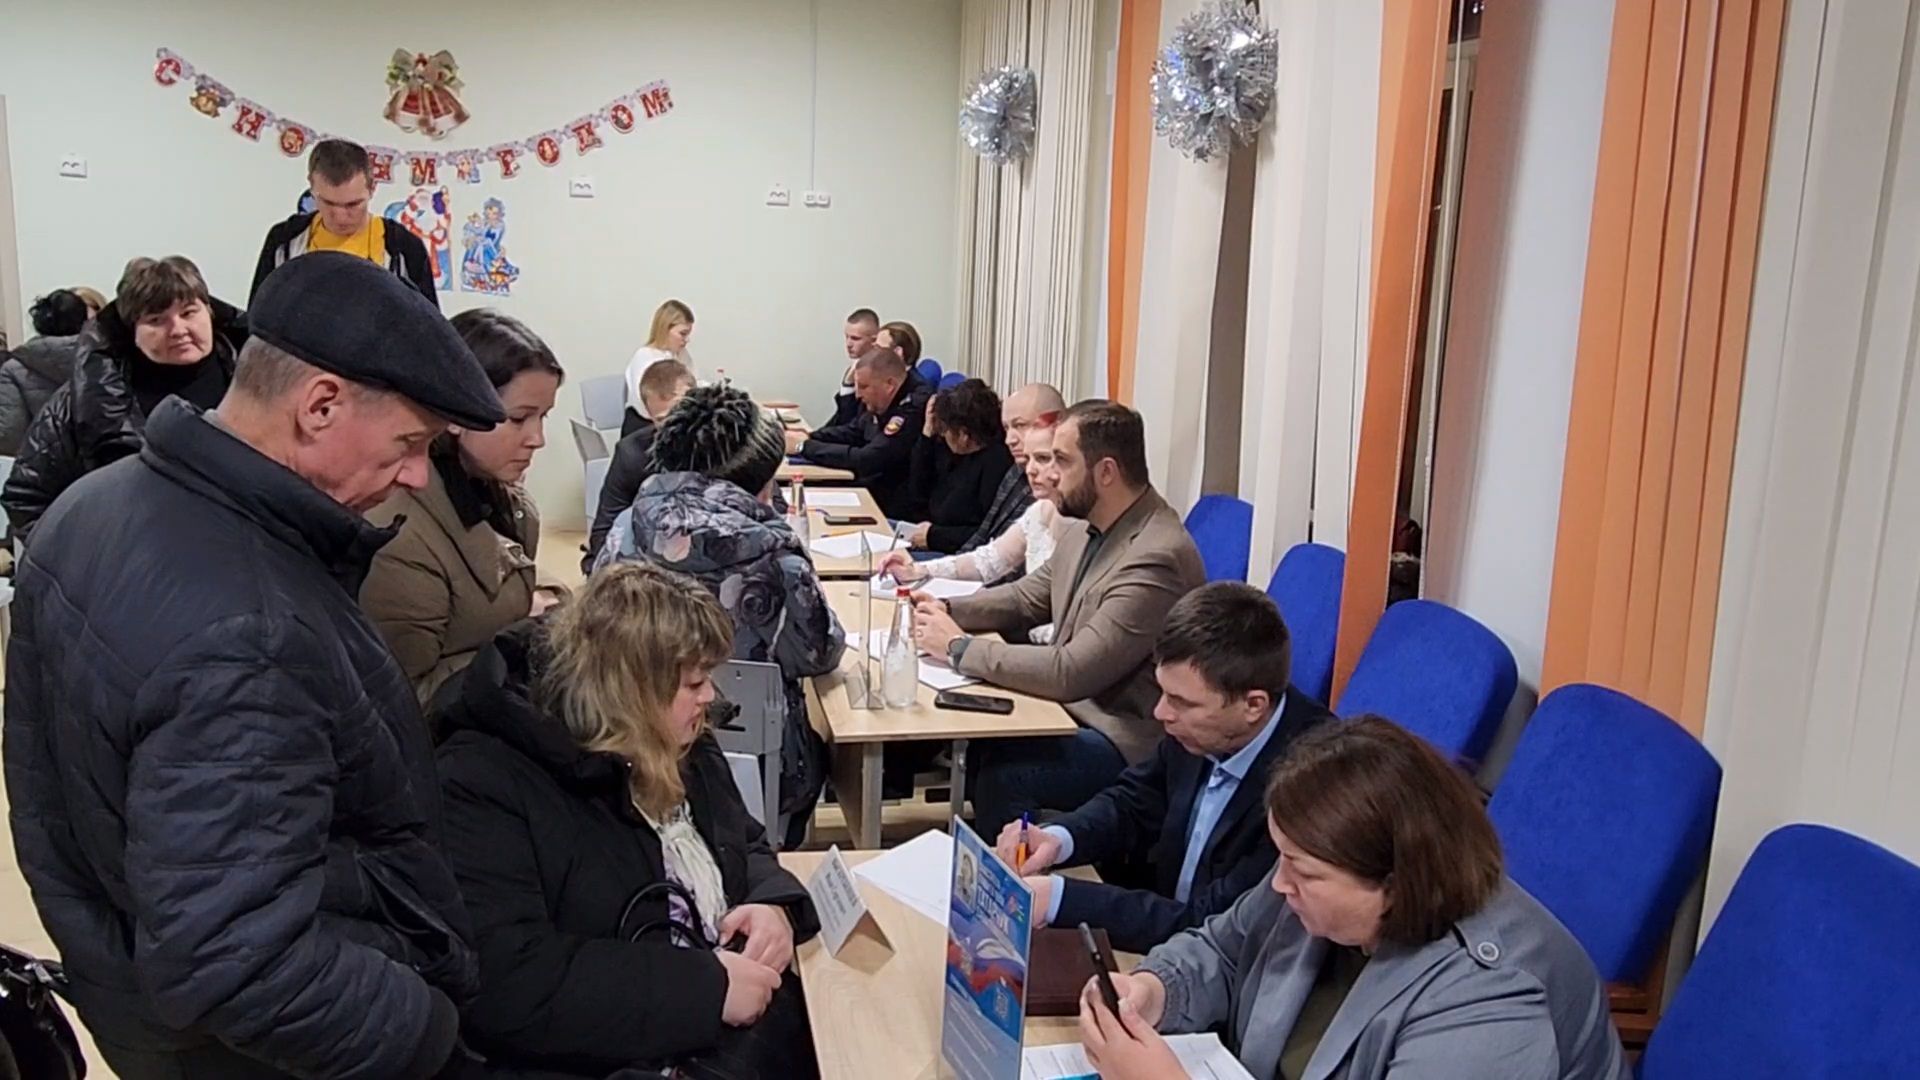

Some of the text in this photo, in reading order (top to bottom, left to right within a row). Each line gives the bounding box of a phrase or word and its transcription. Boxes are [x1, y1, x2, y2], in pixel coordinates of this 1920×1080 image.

[154, 57, 674, 185] С НОЫМ ГОДОМ
